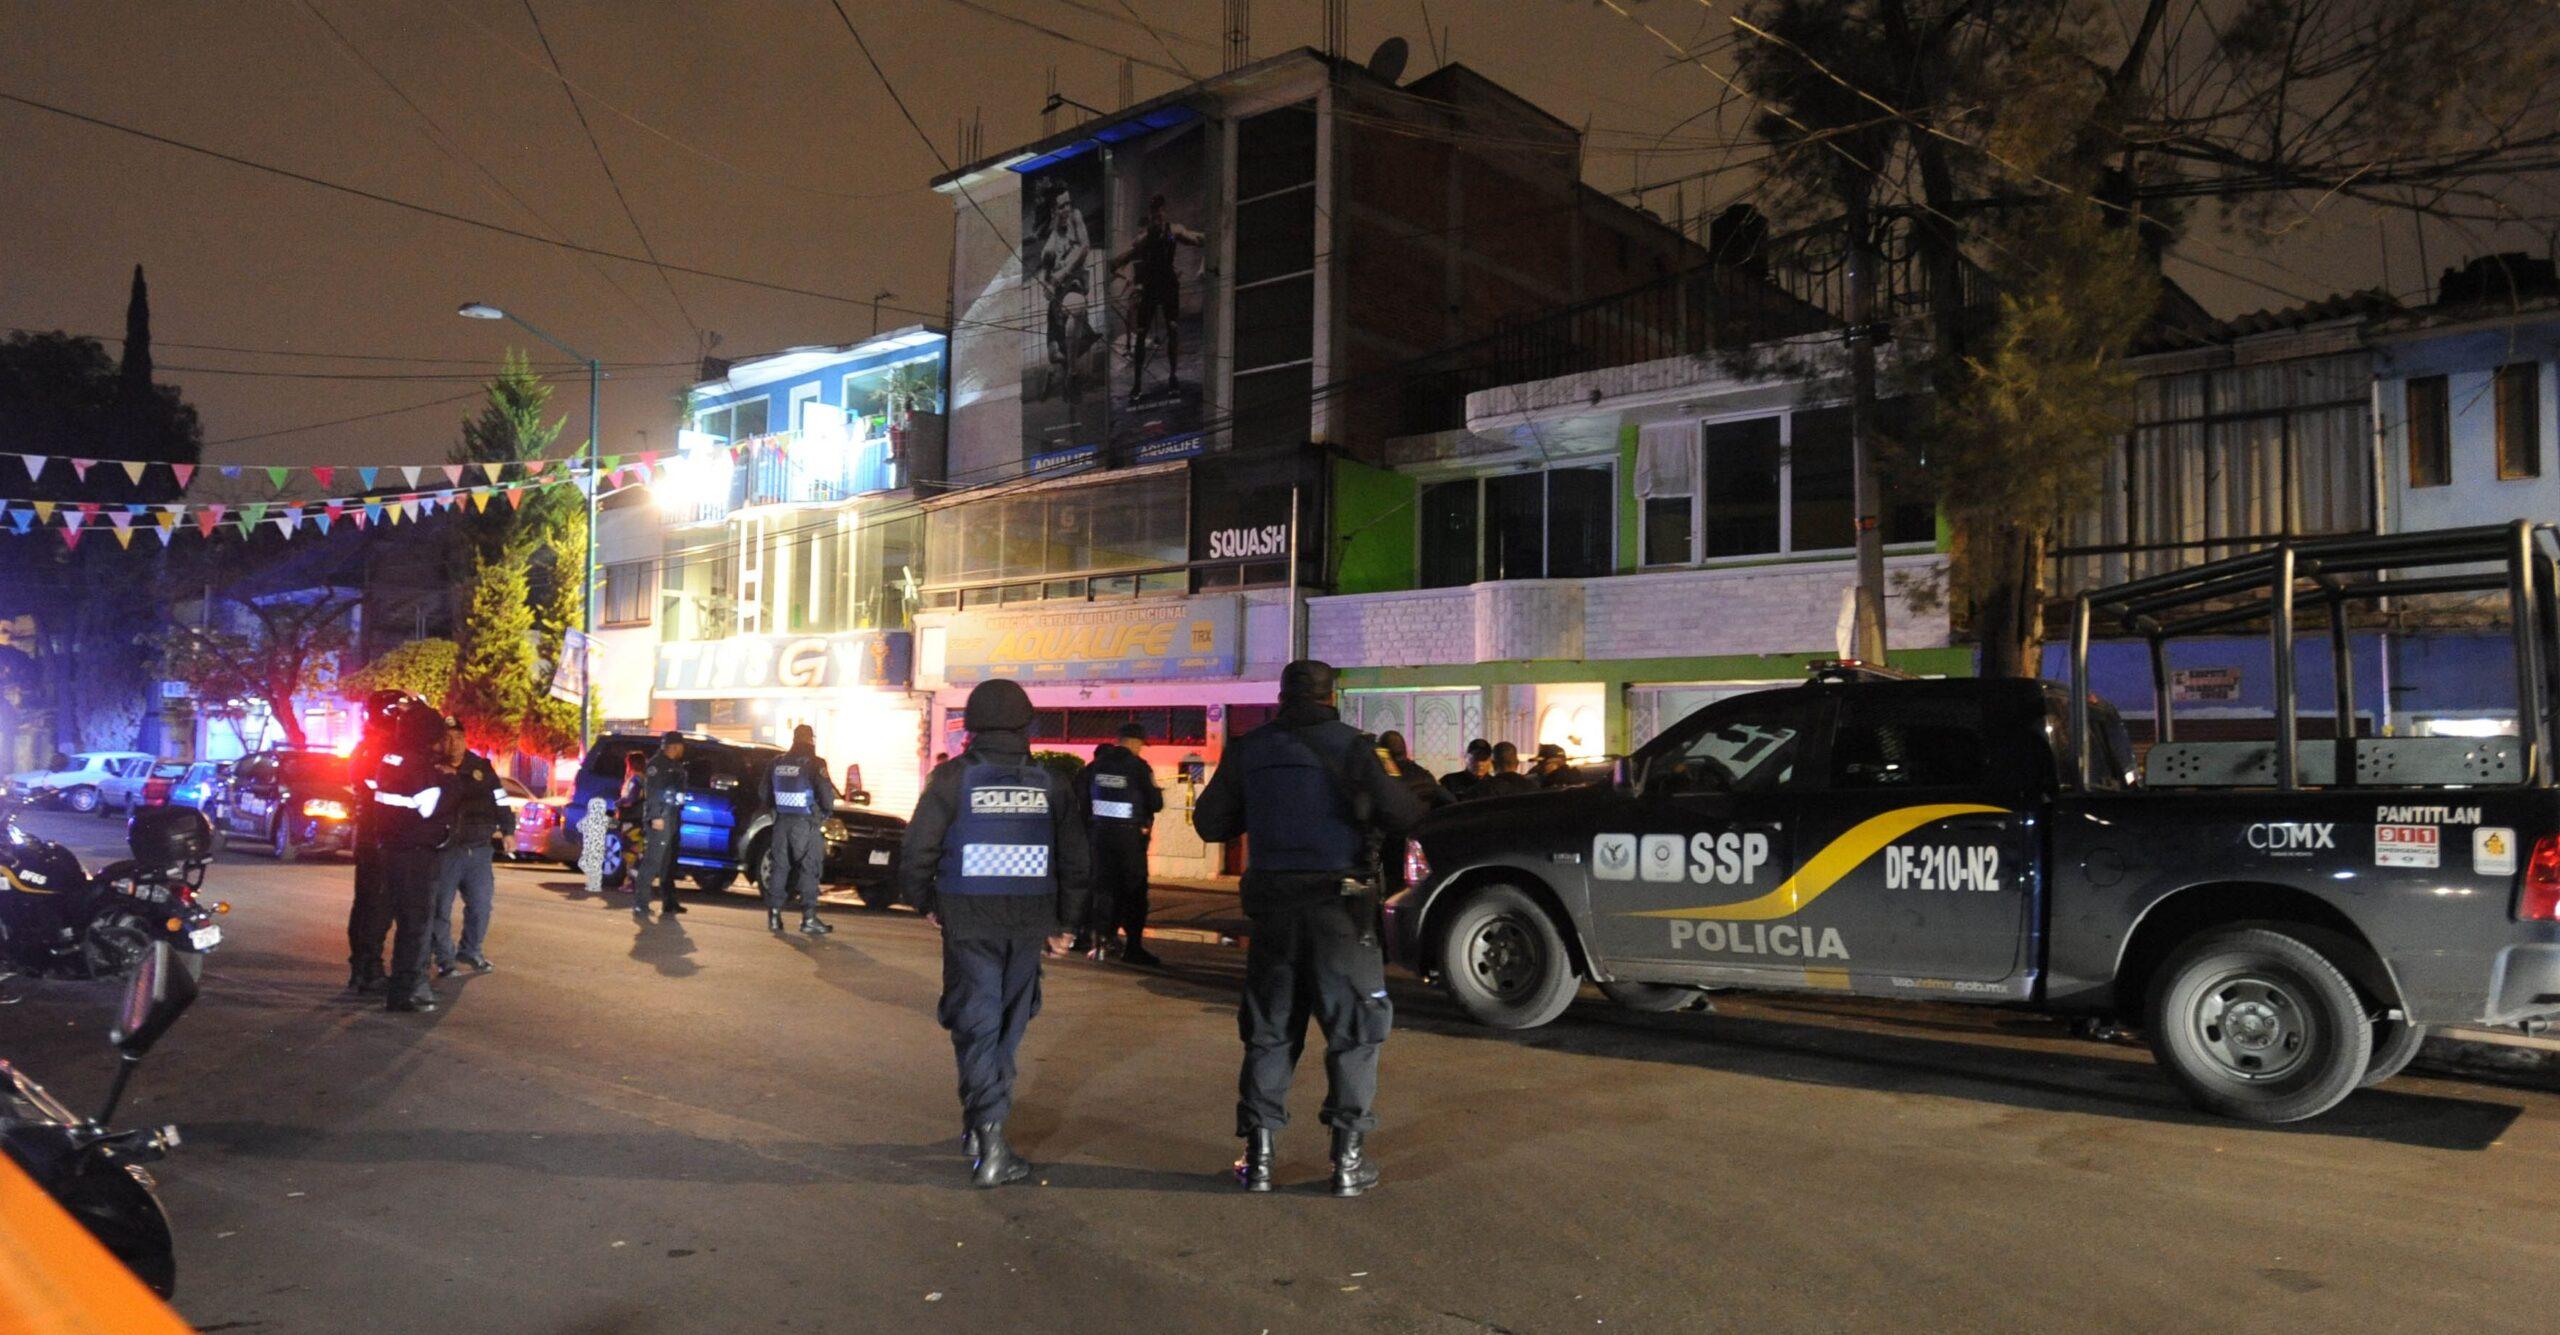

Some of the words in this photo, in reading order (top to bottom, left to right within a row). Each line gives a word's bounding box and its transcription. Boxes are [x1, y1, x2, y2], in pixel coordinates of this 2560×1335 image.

[1138, 437, 1201, 458] AQUALIFE
[1210, 524, 1286, 559] SQUASH
[988, 622, 1176, 662] AQUALIFE
[1191, 629, 1212, 644] TRX
[2376, 806, 2481, 824] PANTITLAN
[2247, 823, 2336, 849] CDMX
[2380, 828, 2435, 843] 911
[1689, 832, 1769, 885] SSP
[1886, 845, 2000, 892] DF-210-N2
[1669, 920, 1850, 960] POLICIA
